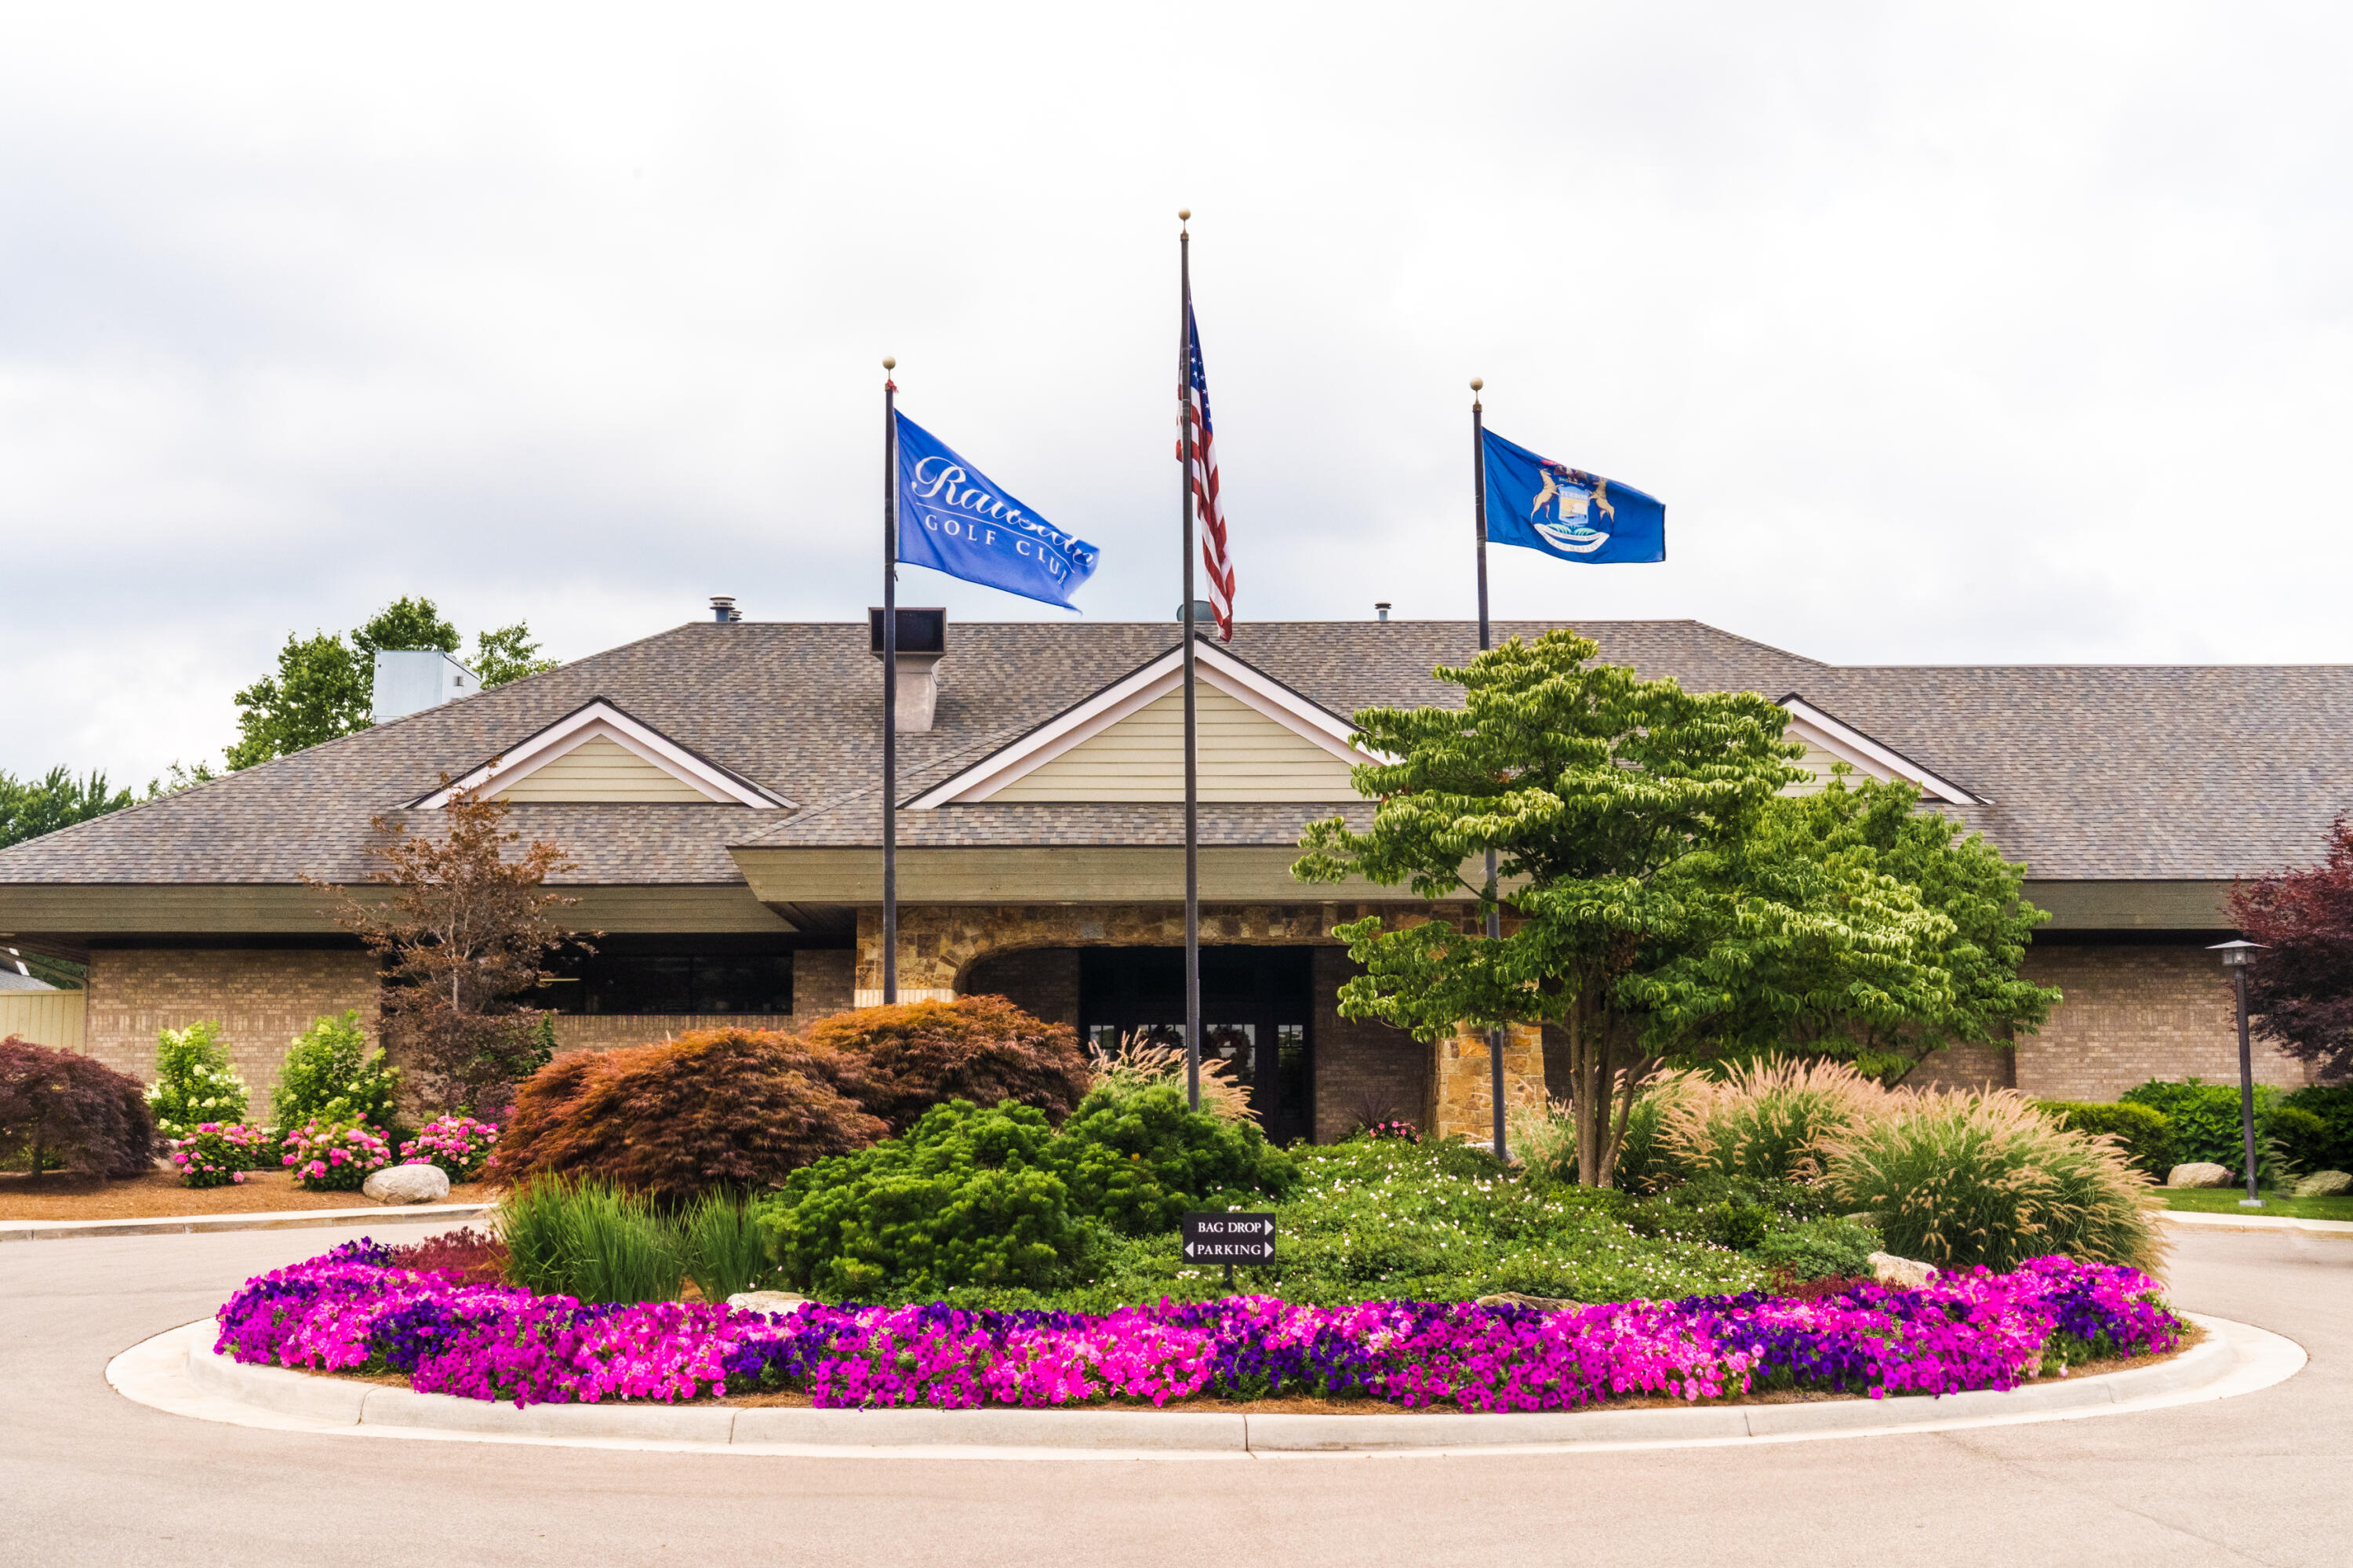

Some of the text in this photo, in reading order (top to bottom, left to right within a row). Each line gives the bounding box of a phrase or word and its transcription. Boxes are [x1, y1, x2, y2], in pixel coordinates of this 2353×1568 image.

[926, 514, 996, 545] GOLF
[1198, 1221, 1262, 1233] BAG DROP
[1197, 1244, 1261, 1255] PARKING
